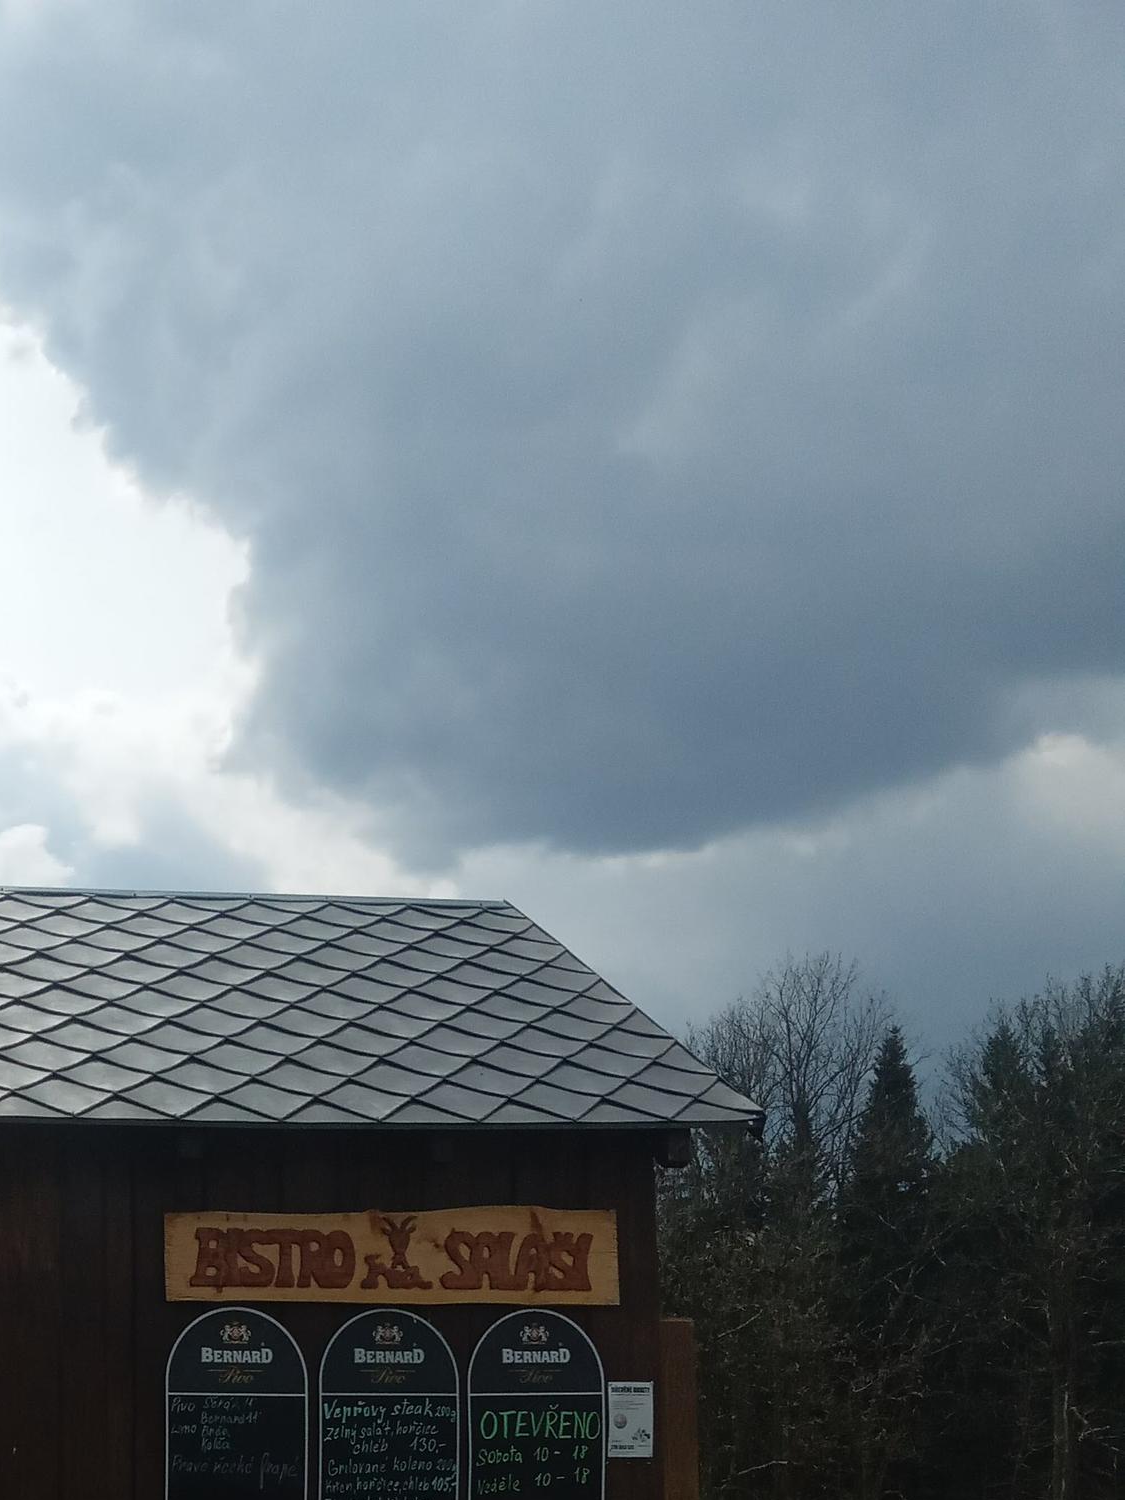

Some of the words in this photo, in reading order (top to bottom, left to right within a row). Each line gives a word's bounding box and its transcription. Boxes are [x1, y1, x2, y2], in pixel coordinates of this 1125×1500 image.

[189, 1227, 356, 1289] BISTRO
[201, 1347, 273, 1364] BERNARD
[354, 1348, 425, 1364] BERNARD
[502, 1348, 571, 1364] BERNARD
[171, 1397, 195, 1413] Pivo
[391, 1398, 433, 1417] steak
[480, 1404, 600, 1440] OTEVŘENO
[476, 1445, 523, 1467] Sobota
[533, 1447, 549, 1462] 10
[572, 1445, 588, 1460] 18
[535, 1473, 551, 1487] 10
[575, 1467, 590, 1484] 18
